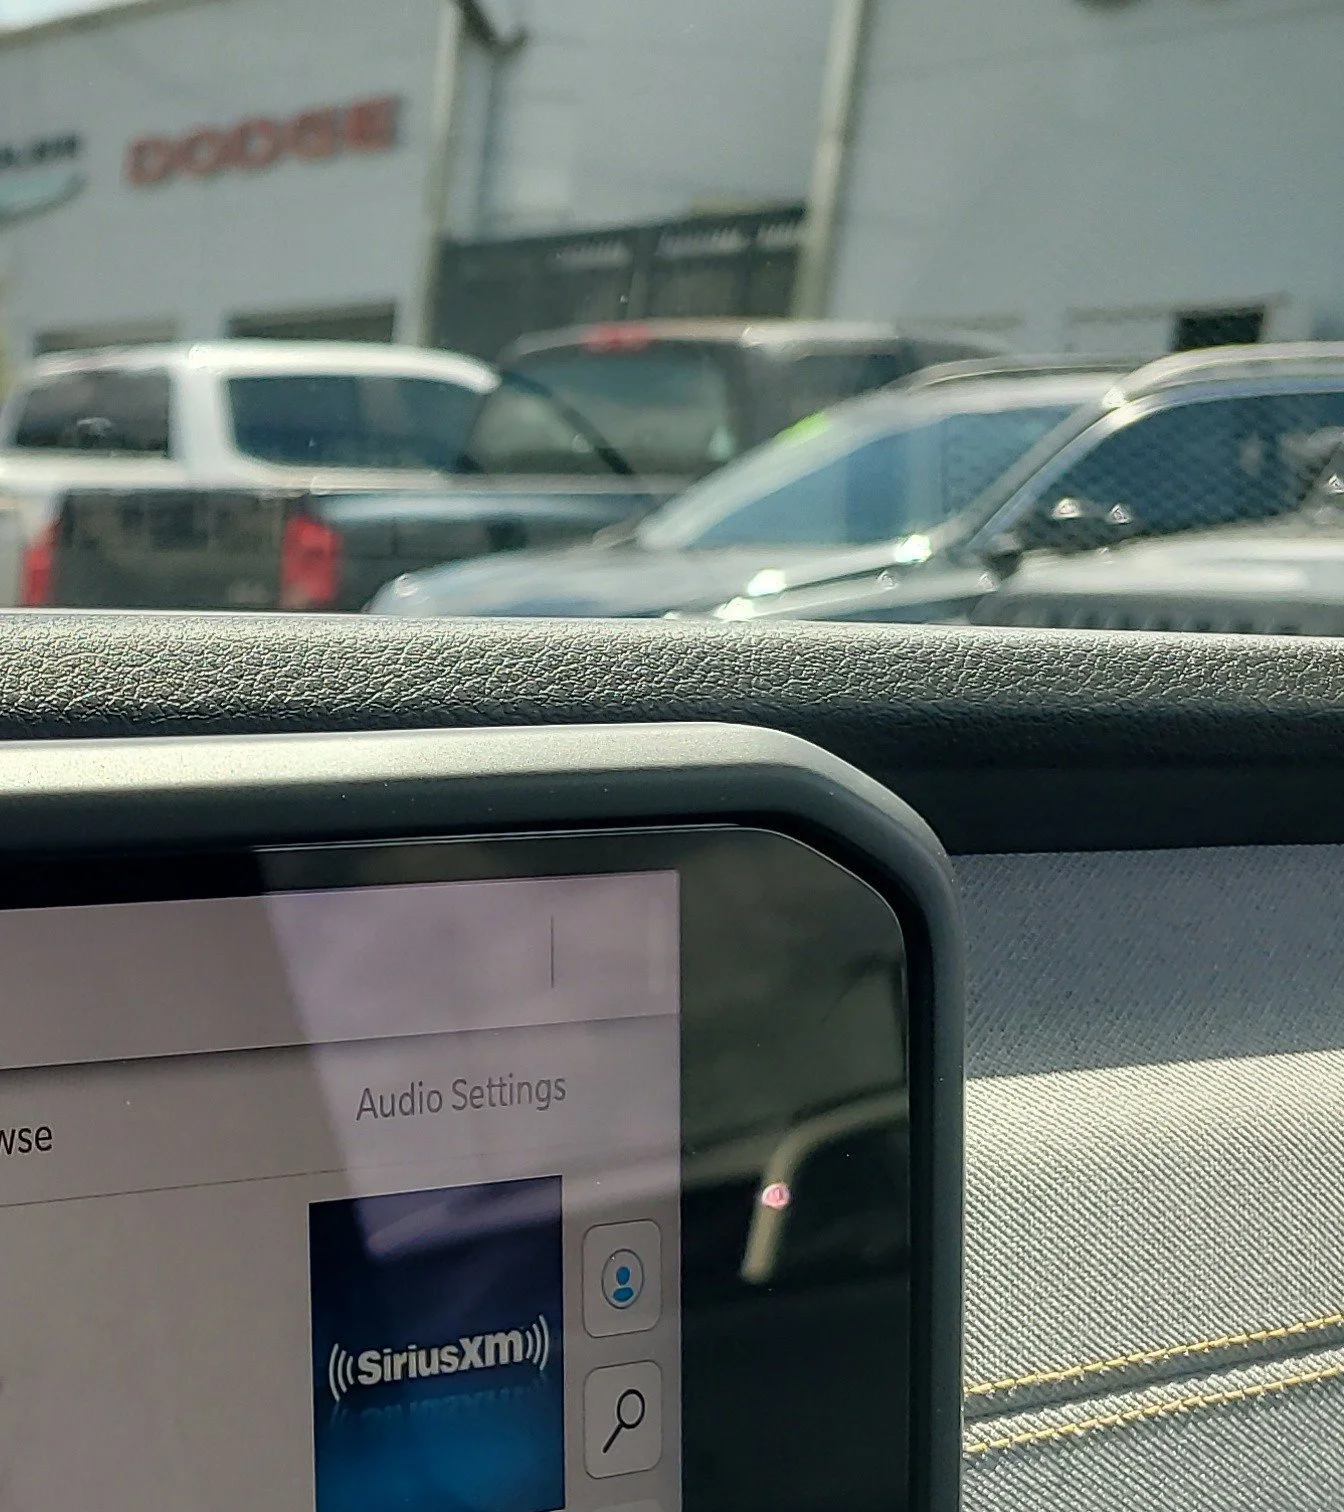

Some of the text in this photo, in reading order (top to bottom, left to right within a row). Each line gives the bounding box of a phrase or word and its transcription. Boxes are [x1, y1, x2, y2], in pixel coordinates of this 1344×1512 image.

[124, 93, 402, 187] DODGE
[356, 1072, 568, 1121] Audio Settings
